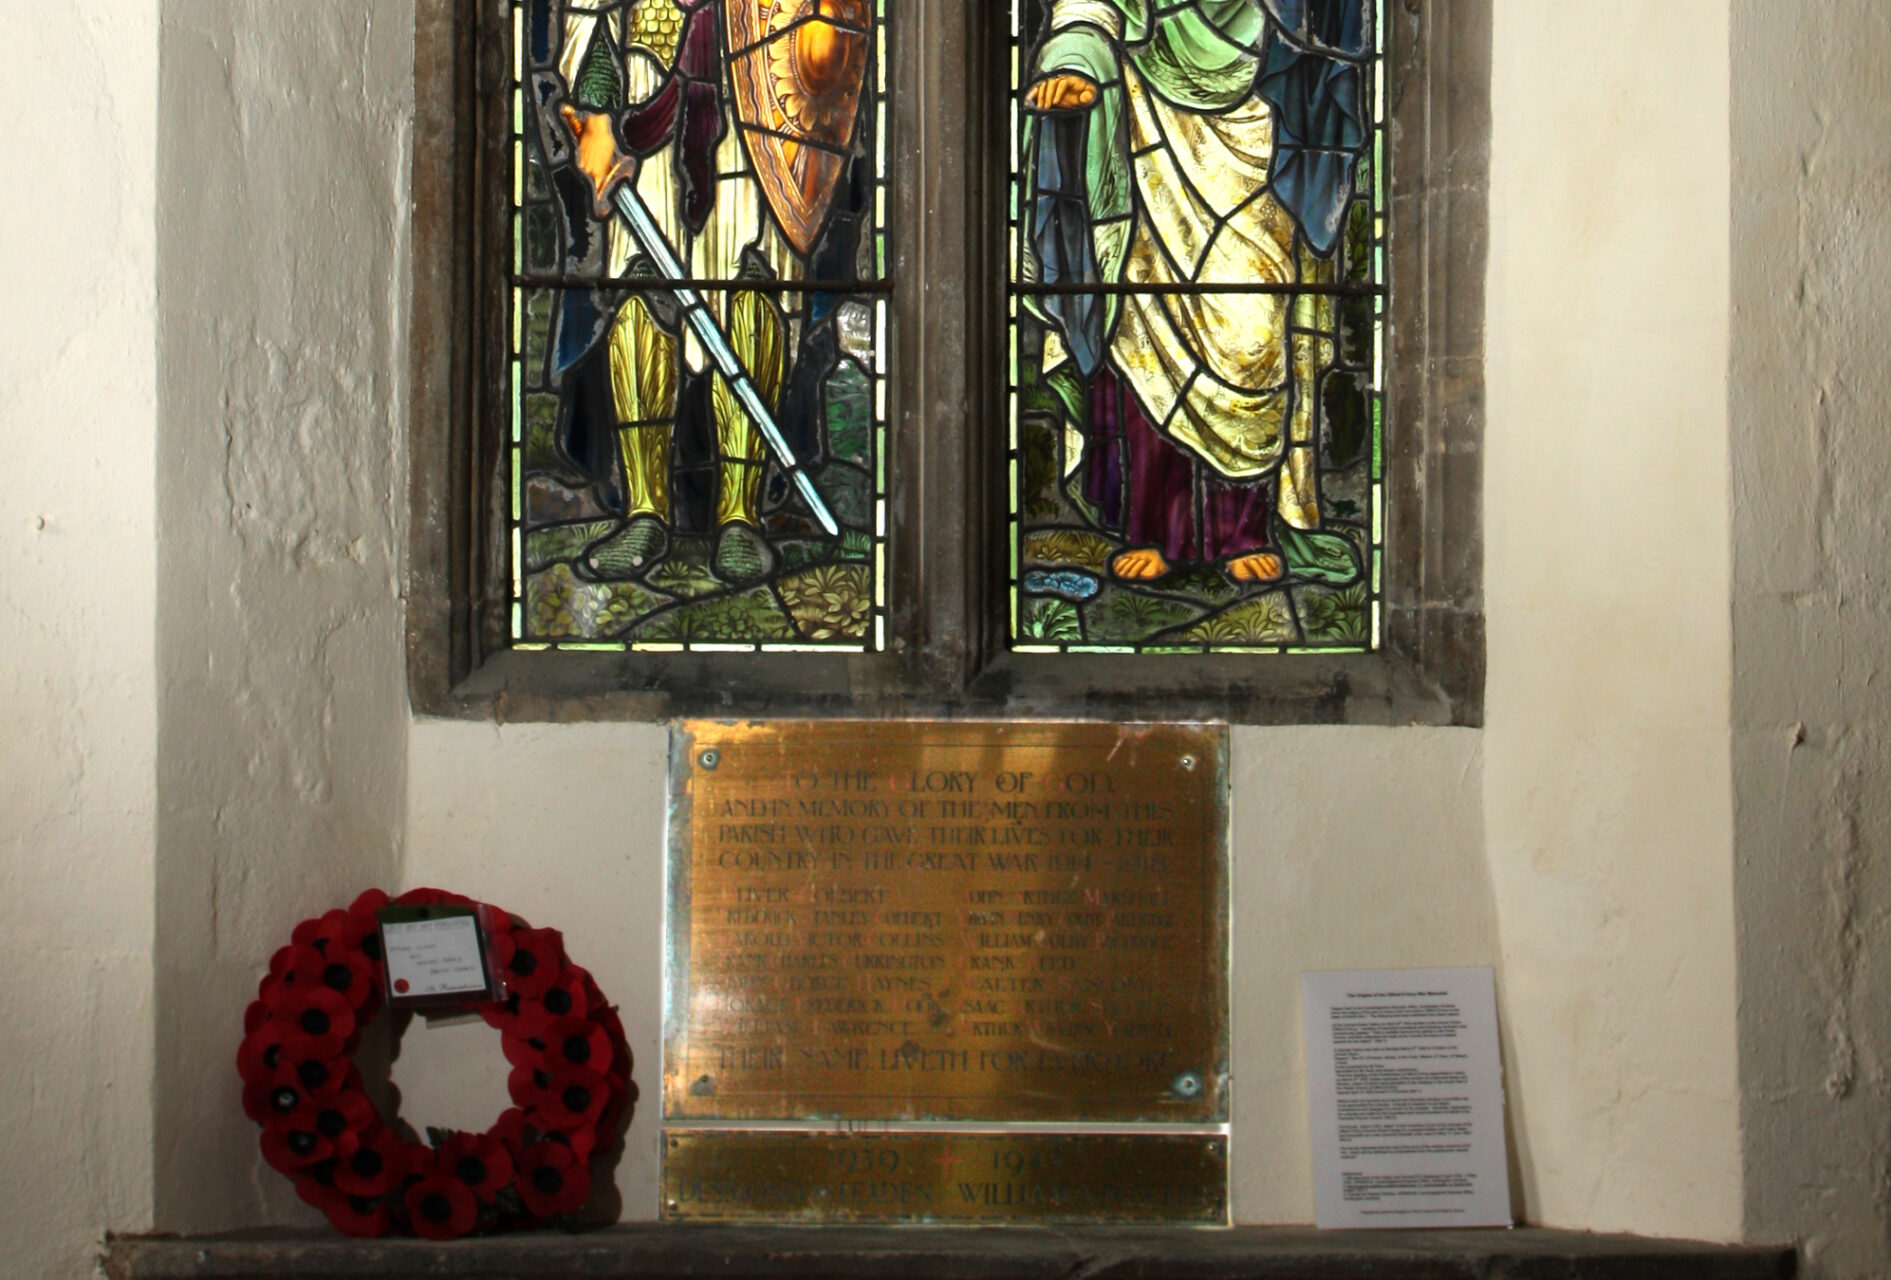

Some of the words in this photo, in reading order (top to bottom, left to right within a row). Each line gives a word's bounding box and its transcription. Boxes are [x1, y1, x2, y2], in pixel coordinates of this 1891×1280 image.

[831, 770, 877, 792] THE
[888, 771, 977, 793] GLORY
[994, 772, 1032, 793] OF
[722, 798, 766, 818] AND
[797, 798, 888, 818] MEMORY
[898, 799, 928, 818] OF
[937, 800, 980, 819] THE
[990, 800, 1038, 820] MEN
[1045, 801, 1110, 819] FROM
[718, 825, 785, 843] PARISH
[796, 825, 855, 844] WHO
[861, 825, 920, 844] GAVE
[928, 826, 986, 845] THEIR
[991, 827, 1051, 846] LIVES
[1060, 827, 1102, 846] FOR
[718, 851, 818, 871] COUNTRY
[831, 851, 853, 870] IN
[864, 851, 899, 870] THE
[907, 852, 978, 871] GREAT
[987, 852, 1040, 872] WAR
[714, 1046, 784, 1070] THEIR
[979, 1049, 1028, 1072] FOR
